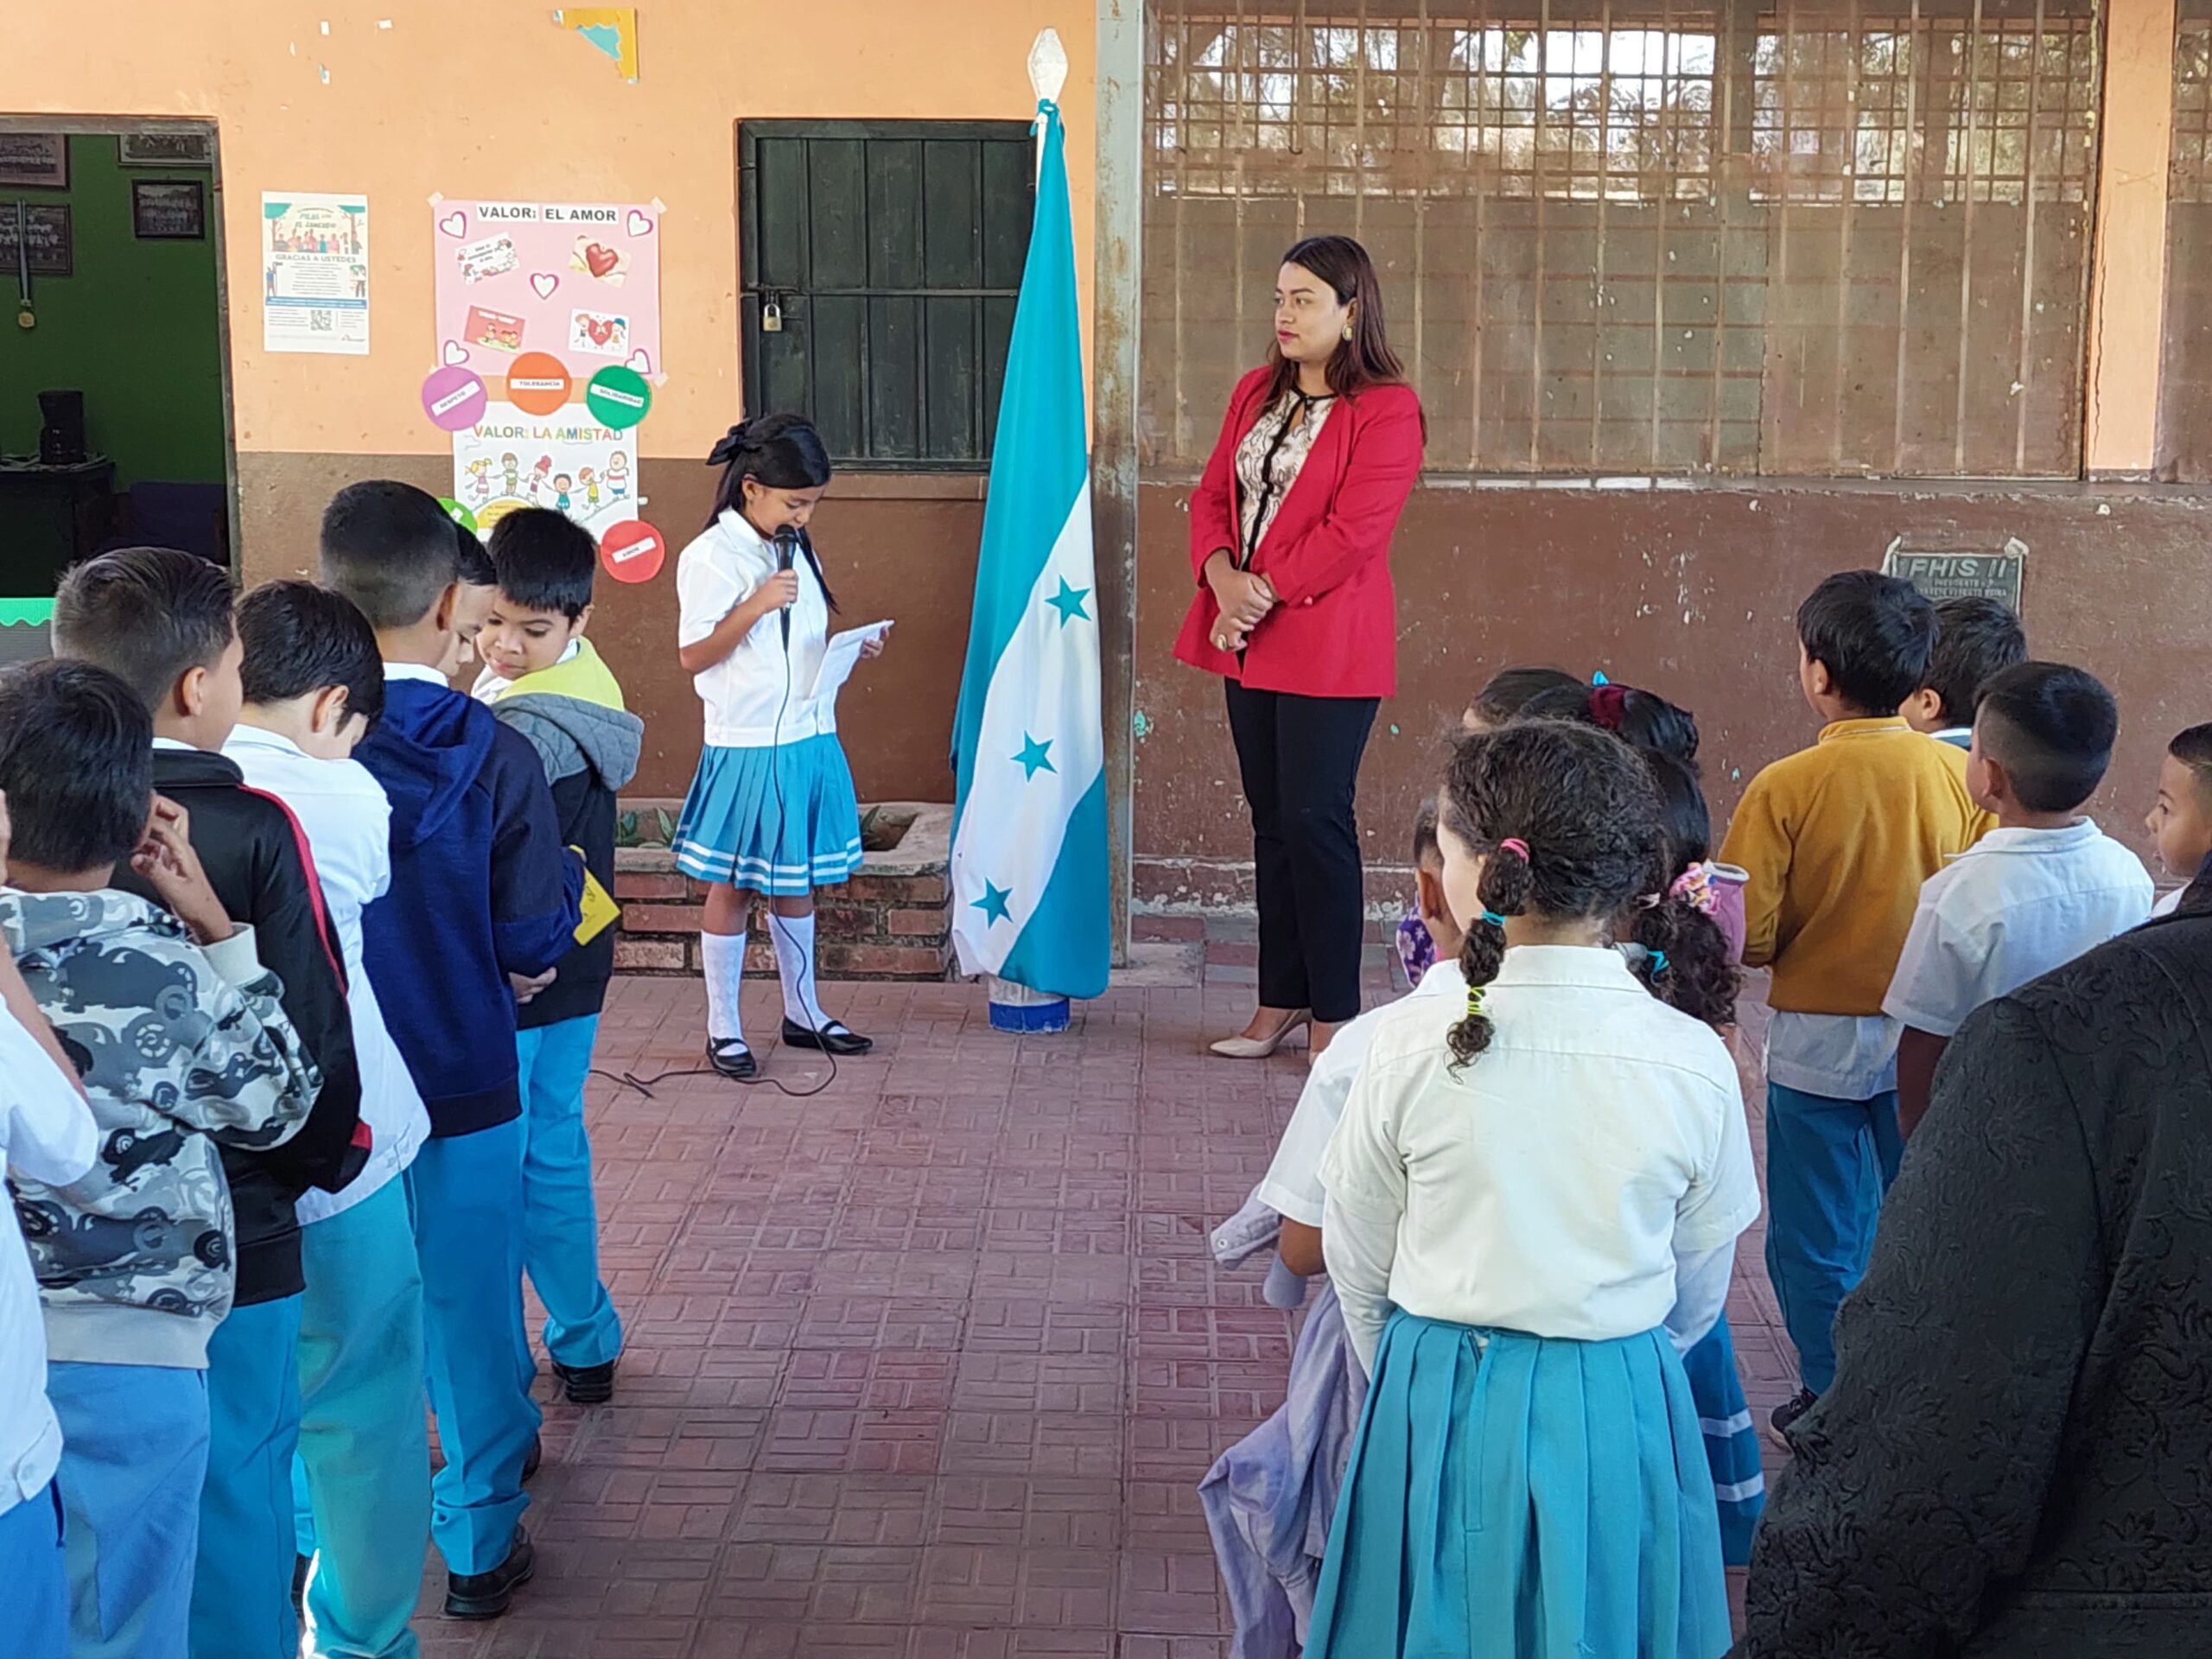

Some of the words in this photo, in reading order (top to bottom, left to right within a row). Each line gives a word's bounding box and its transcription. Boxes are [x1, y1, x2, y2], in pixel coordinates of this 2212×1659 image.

[478, 207, 537, 219] VALOR:
[544, 208, 564, 220] EL
[569, 209, 617, 221] AMOR
[440, 391, 467, 408] RESPETO
[599, 388, 642, 404] SOLIDARIDAD
[474, 424, 529, 439] VALOR:
[533, 427, 552, 440] LA
[556, 428, 623, 442] AMISTAD
[1908, 559, 1979, 577] FHIS
